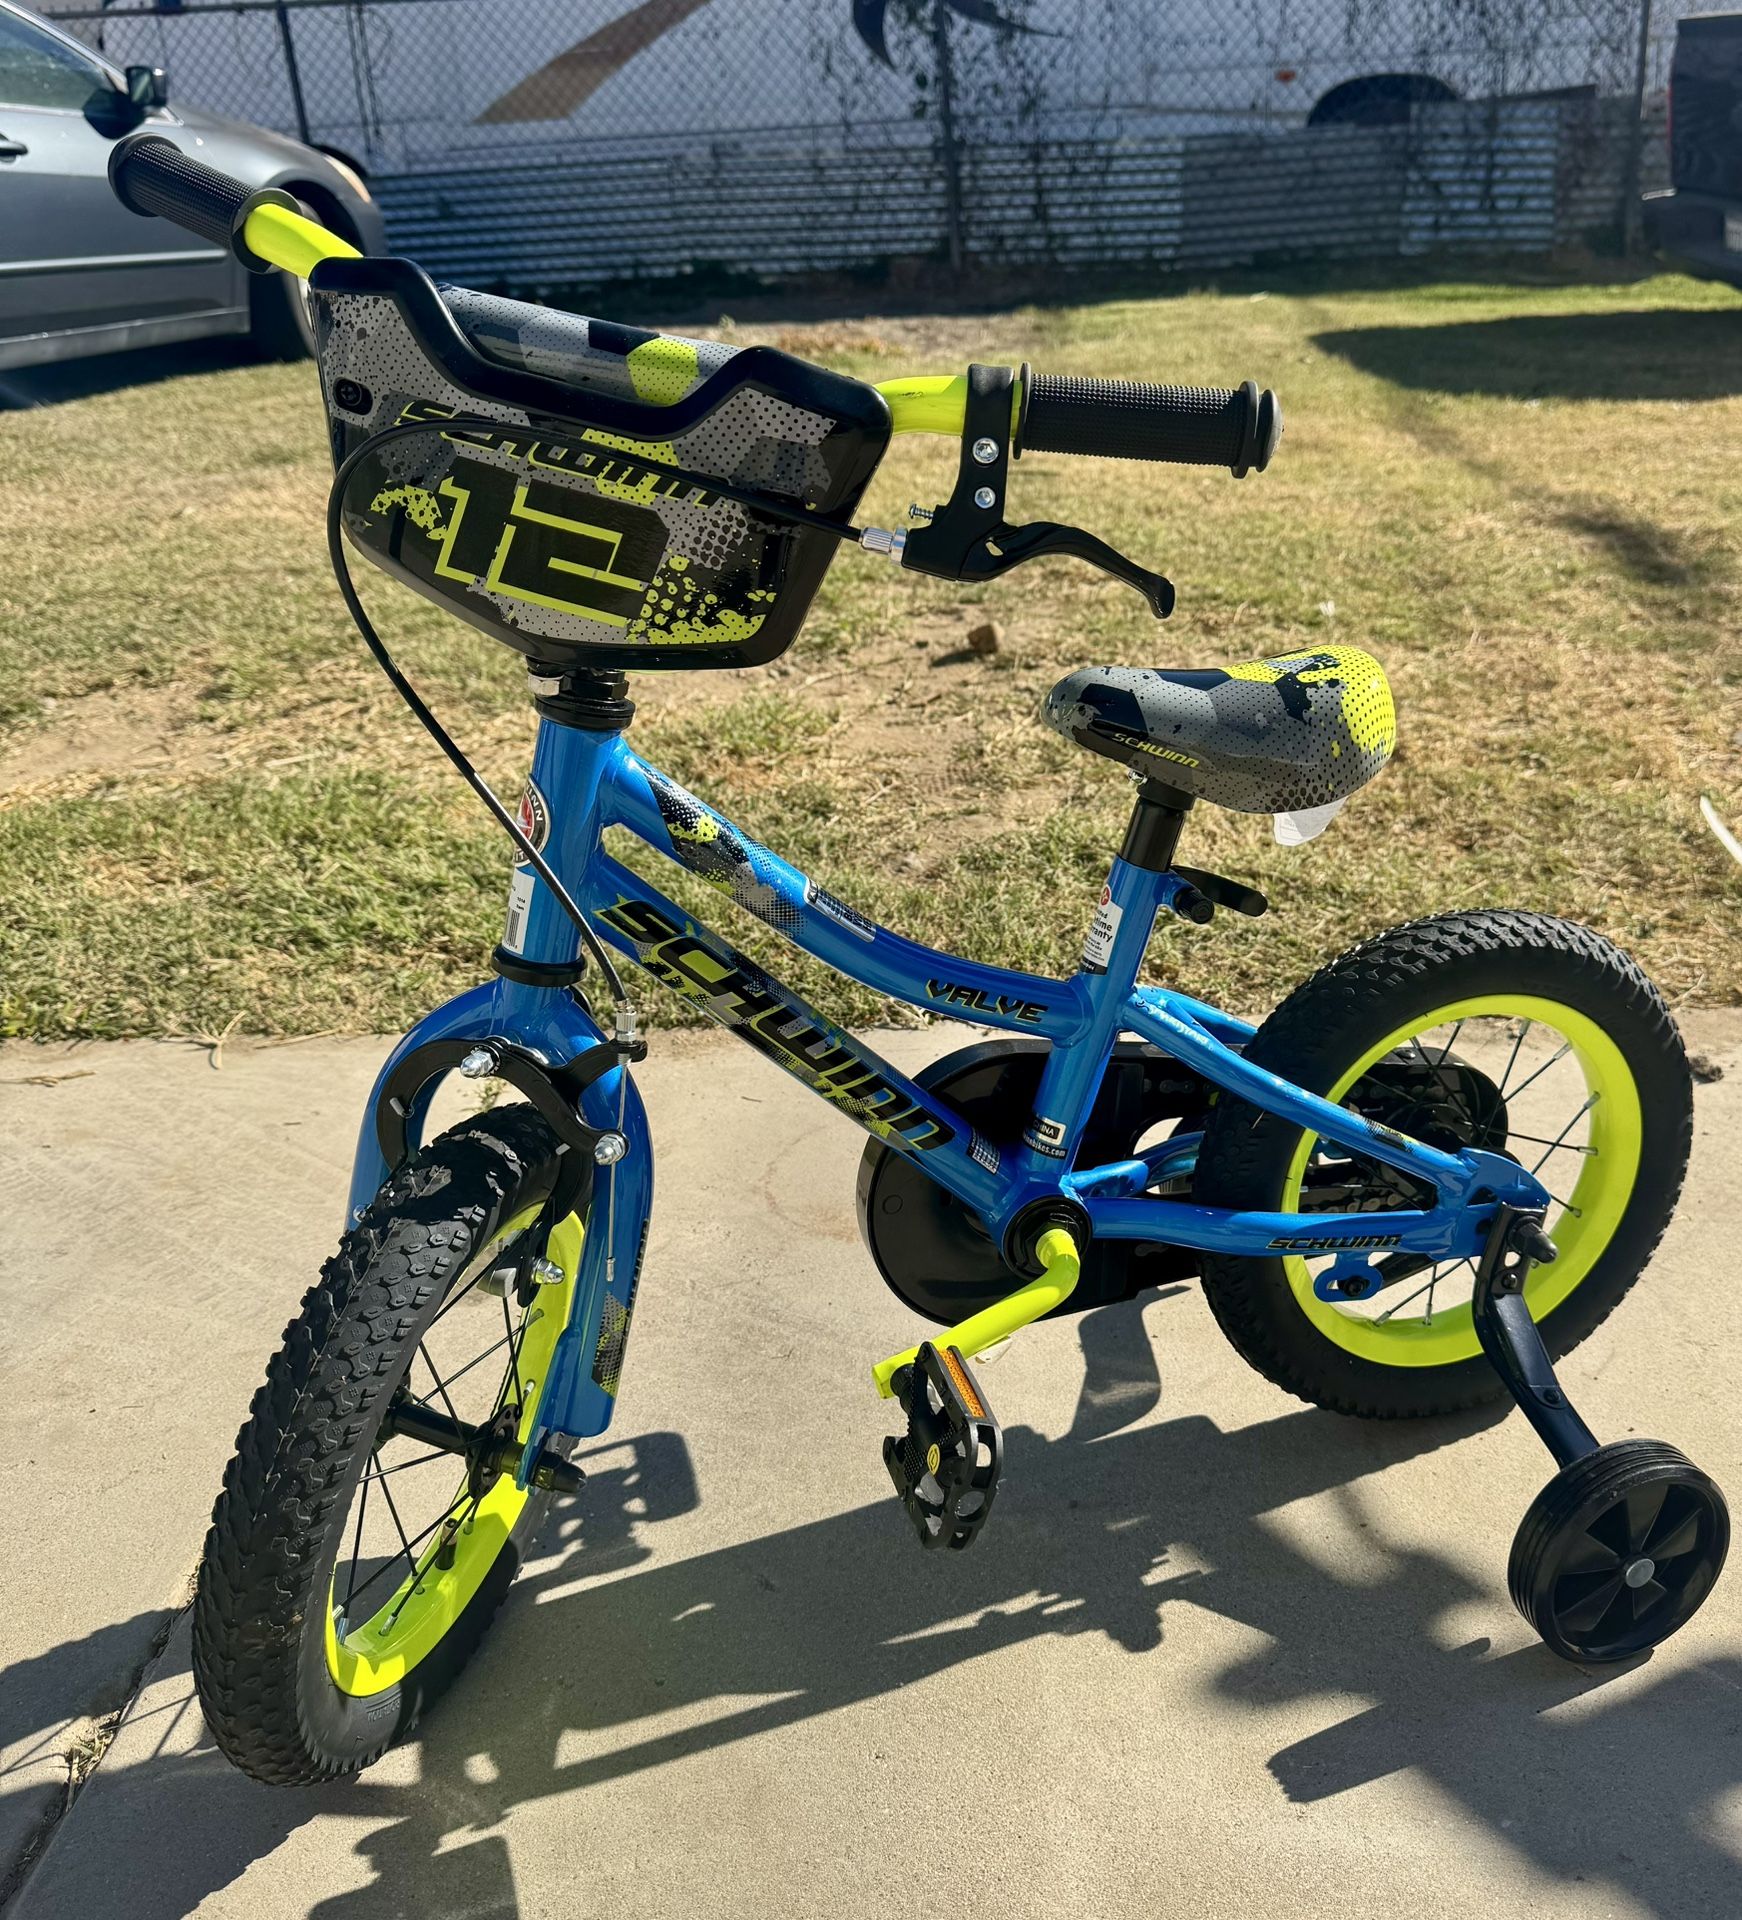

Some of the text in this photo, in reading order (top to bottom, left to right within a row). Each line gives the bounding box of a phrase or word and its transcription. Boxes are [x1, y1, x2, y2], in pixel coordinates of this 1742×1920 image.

[434, 456, 668, 628] 12
[1112, 733, 1200, 768] SCHWINN
[925, 979, 1049, 1023] VALVE
[592, 898, 956, 1150] SCHWINN
[1265, 1233, 1402, 1249] SCHWINN
